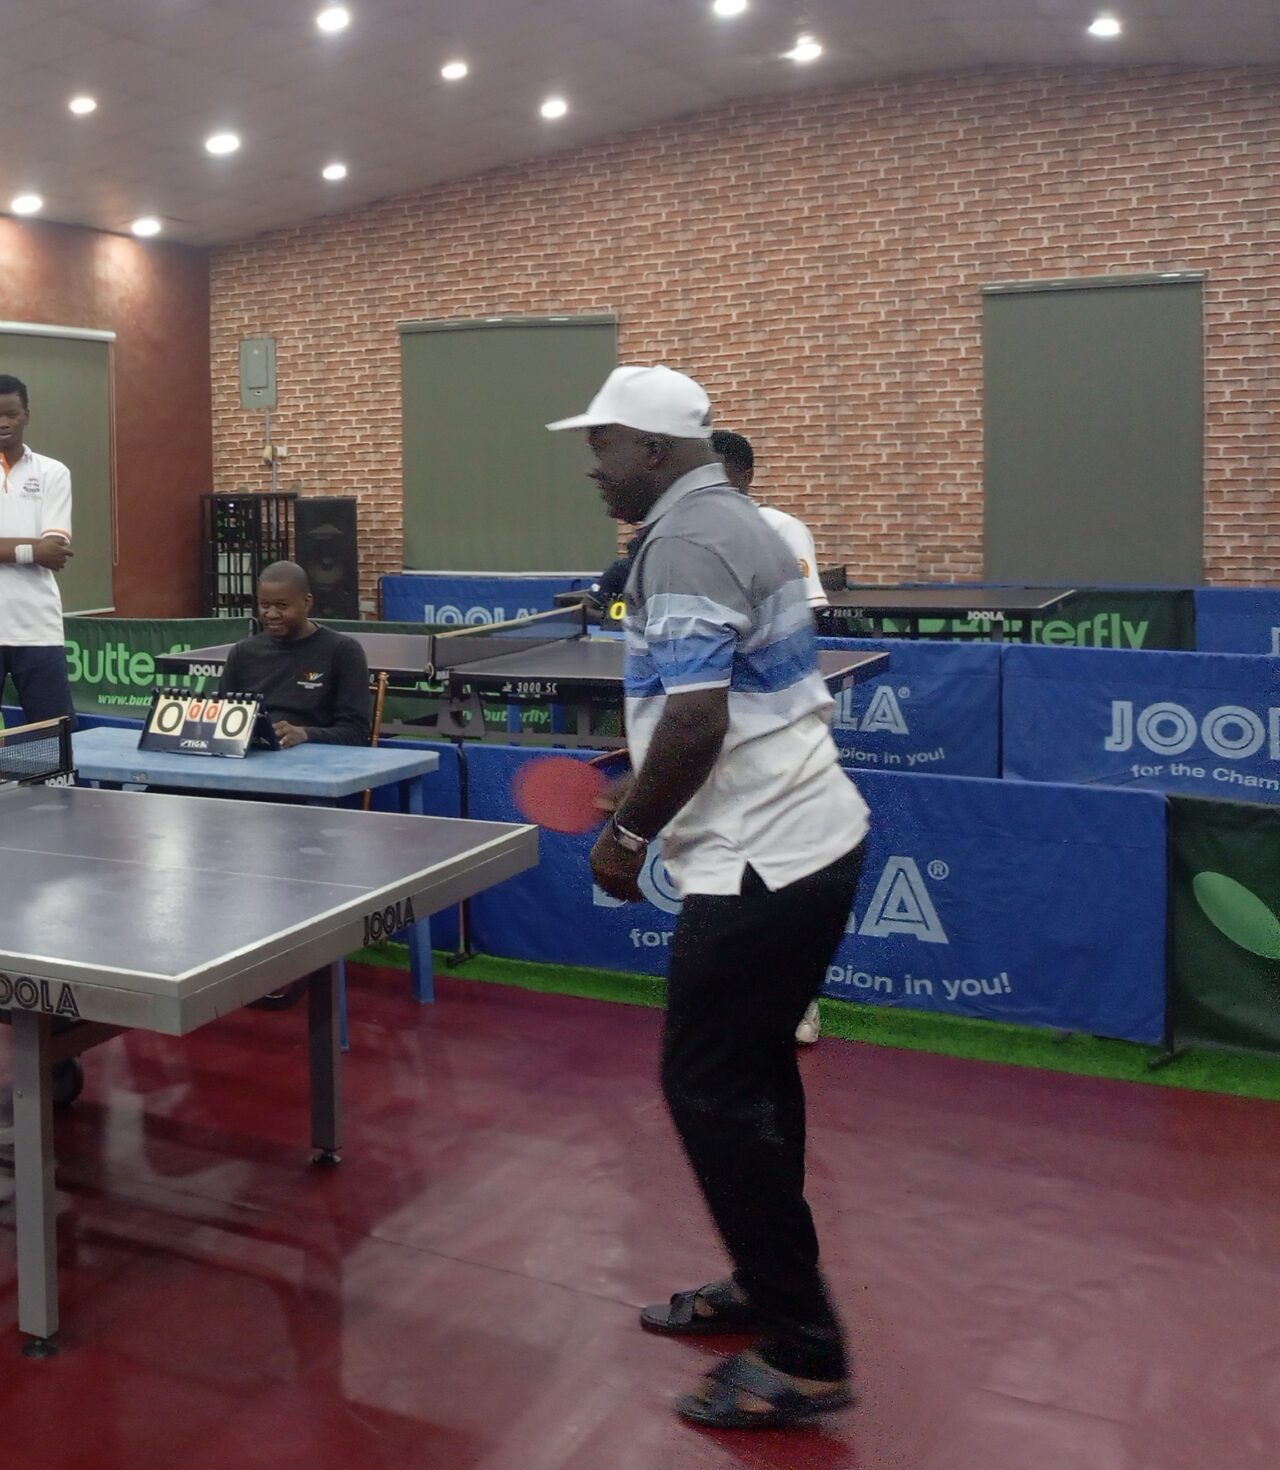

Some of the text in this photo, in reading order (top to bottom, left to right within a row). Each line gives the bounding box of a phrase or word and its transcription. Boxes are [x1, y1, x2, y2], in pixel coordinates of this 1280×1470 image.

[967, 611, 1004, 621] JOOLA
[157, 702, 248, 737] 0 0 0 0
[180, 740, 208, 749] STIGA
[884, 751, 900, 764] in
[906, 747, 945, 766] you!
[1131, 763, 1280, 791] for the Cham
[363, 896, 415, 947] JOOLA
[629, 928, 674, 948] for
[904, 974, 933, 995] in
[942, 972, 1012, 1000] you!
